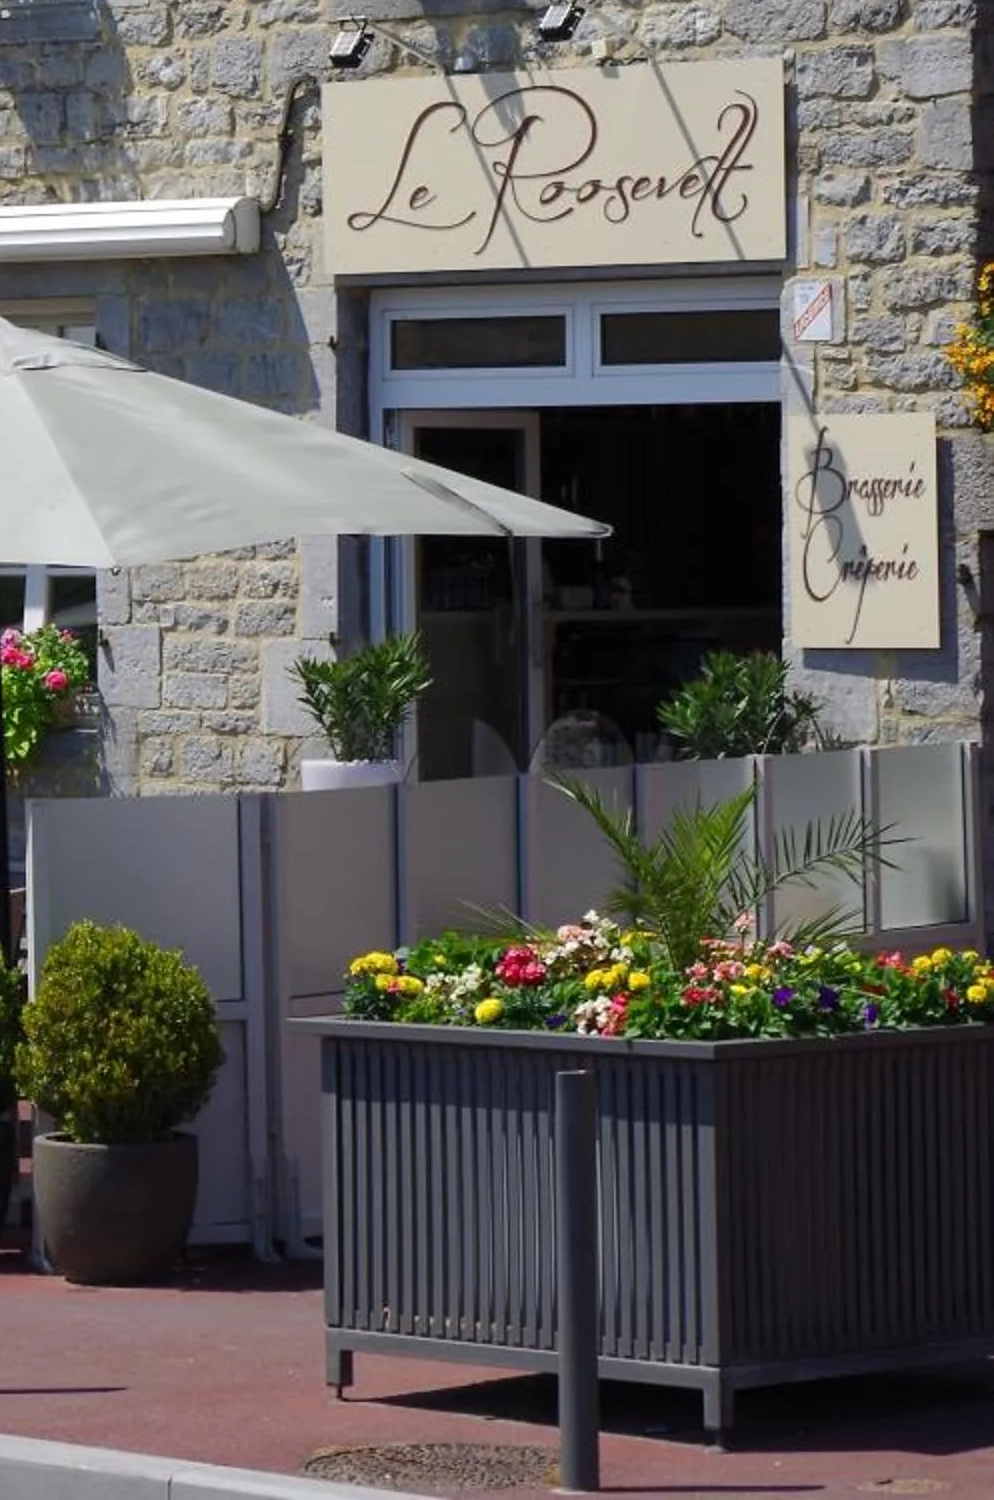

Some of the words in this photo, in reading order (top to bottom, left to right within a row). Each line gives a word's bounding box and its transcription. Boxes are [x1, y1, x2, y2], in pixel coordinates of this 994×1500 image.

[347, 101, 476, 231] Le
[471, 85, 758, 255] Roosevelt
[795, 426, 926, 539] Brasserie
